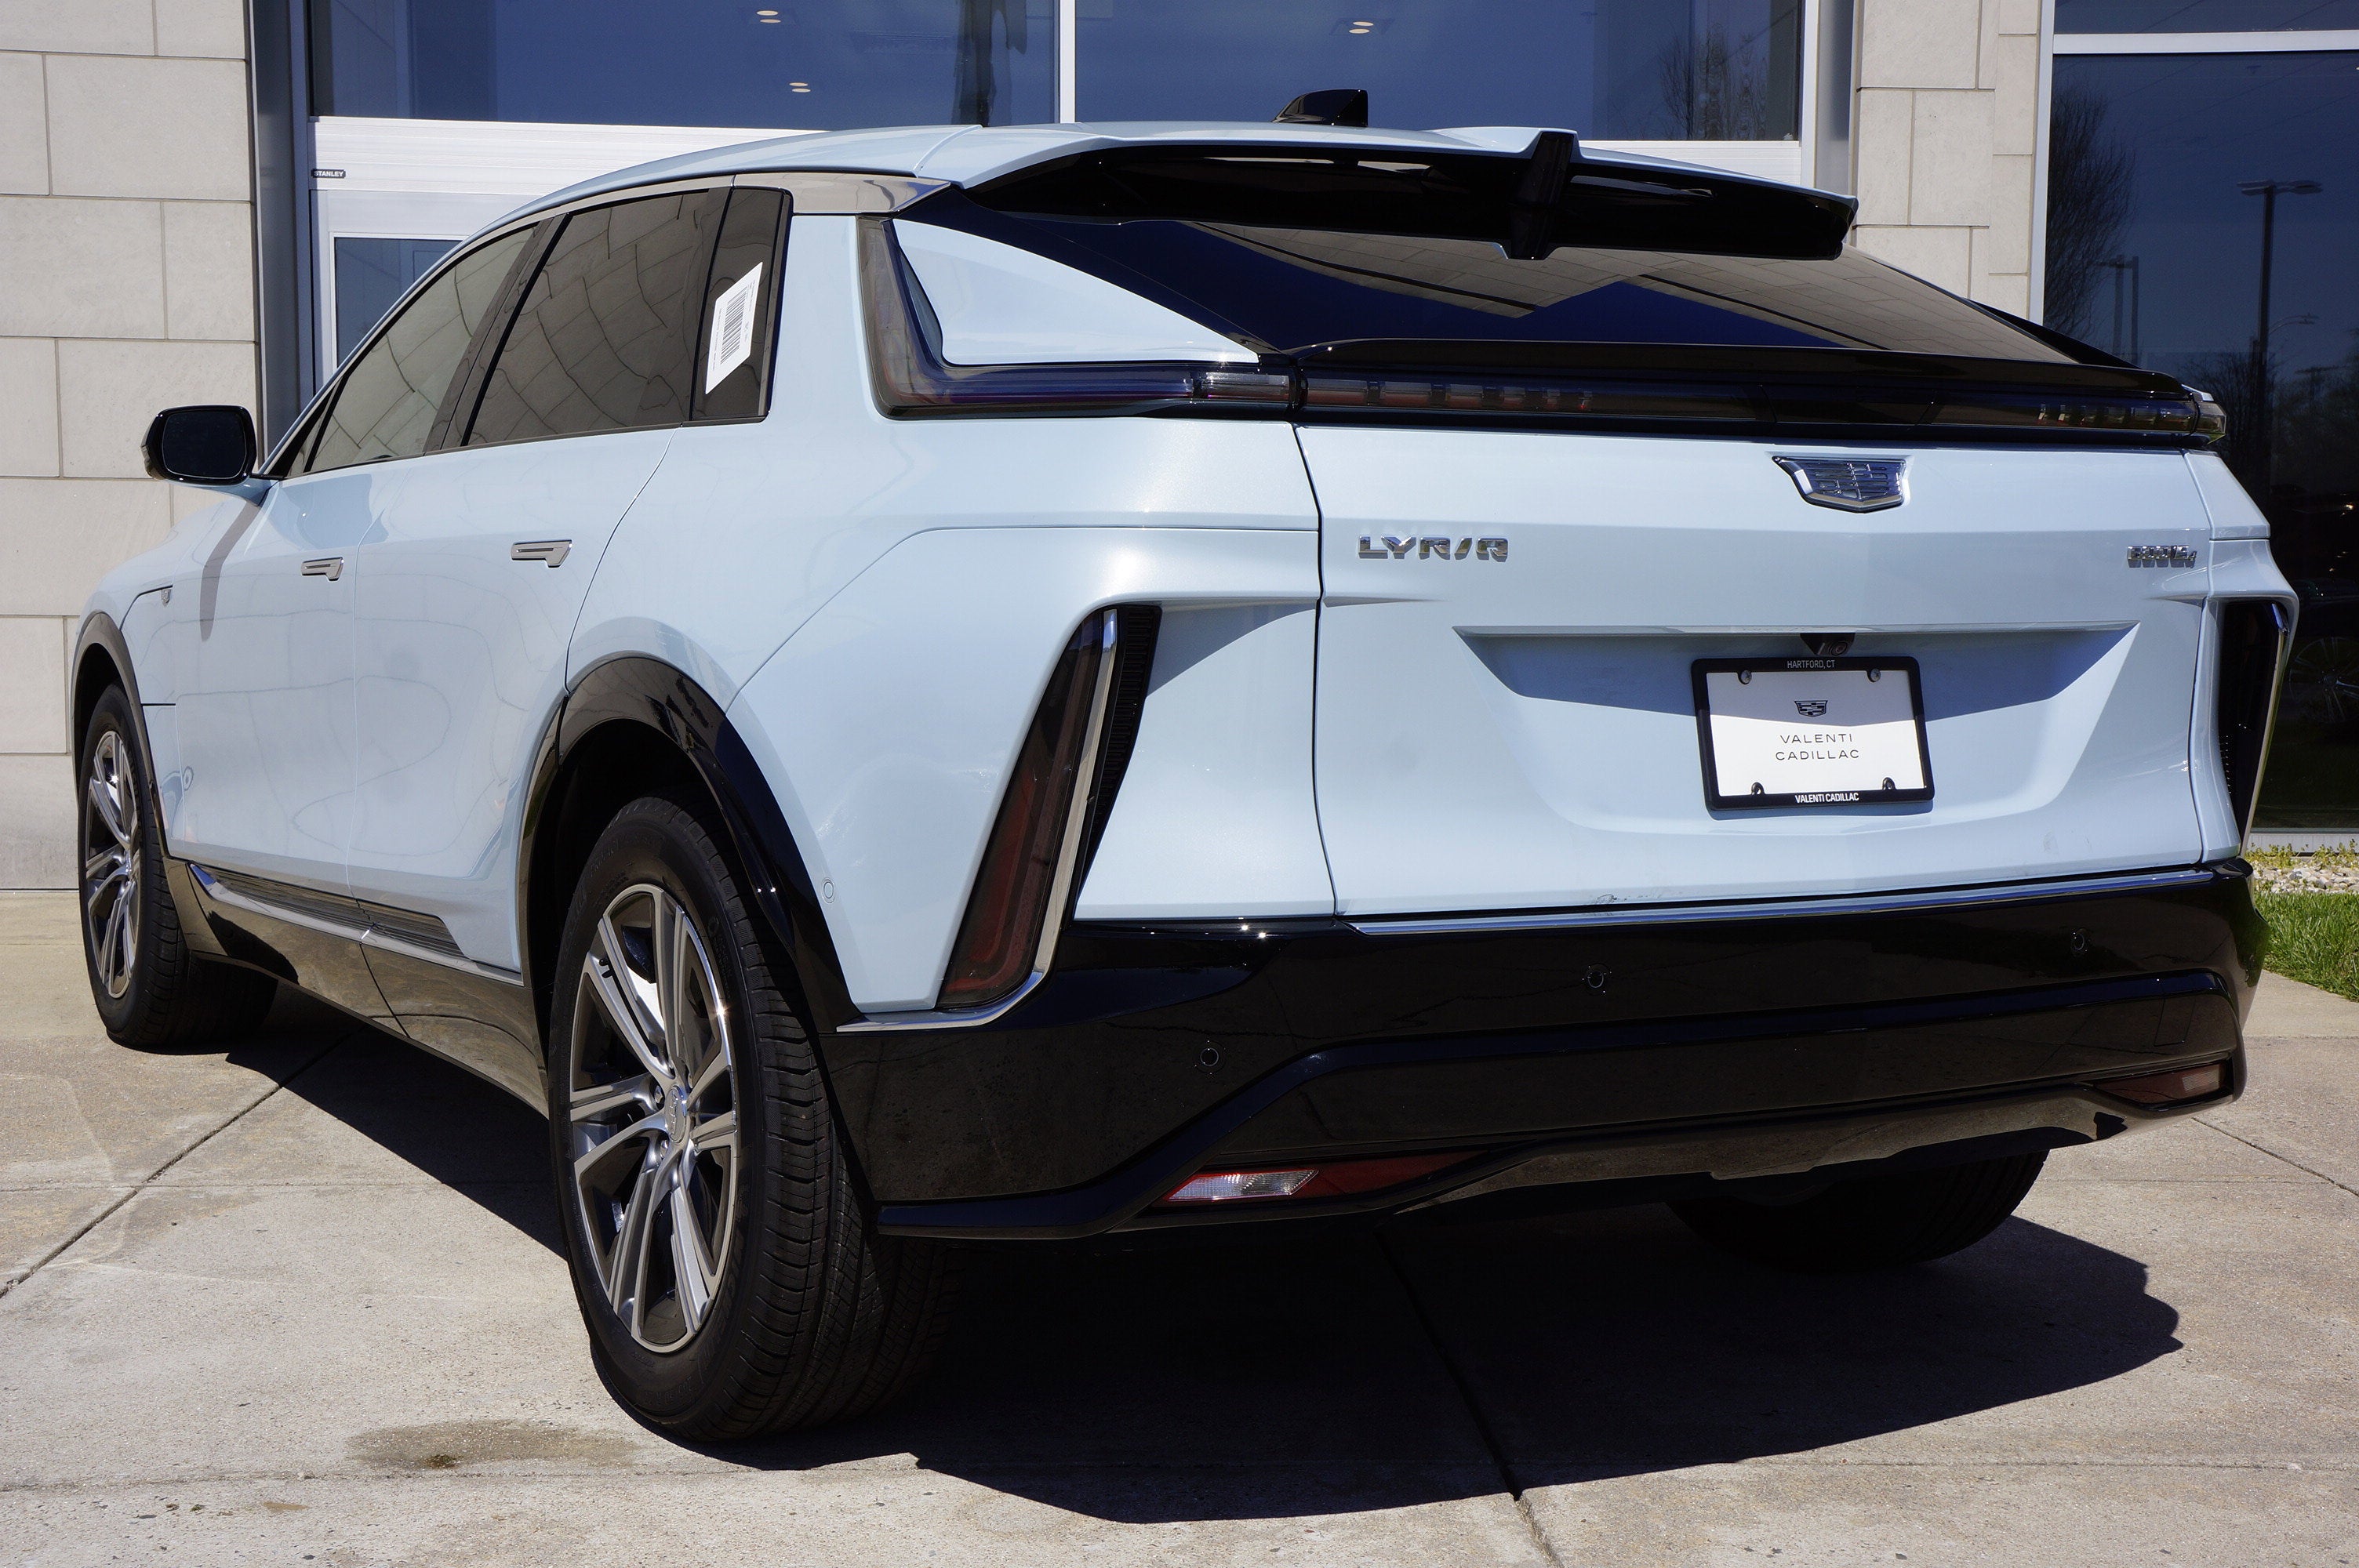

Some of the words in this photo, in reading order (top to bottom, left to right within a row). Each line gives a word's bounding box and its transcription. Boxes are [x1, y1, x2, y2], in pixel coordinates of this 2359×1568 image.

[1358, 536, 1509, 562] LYRIQ
[1787, 660, 1826, 669] HARTFORD,
[1826, 659, 1835, 668] CT
[1780, 733, 1852, 744] VALENTI
[1776, 750, 1859, 761] CADILLAC
[1794, 793, 1825, 804] VALENTI
[1825, 792, 1859, 803] CADILLAC
